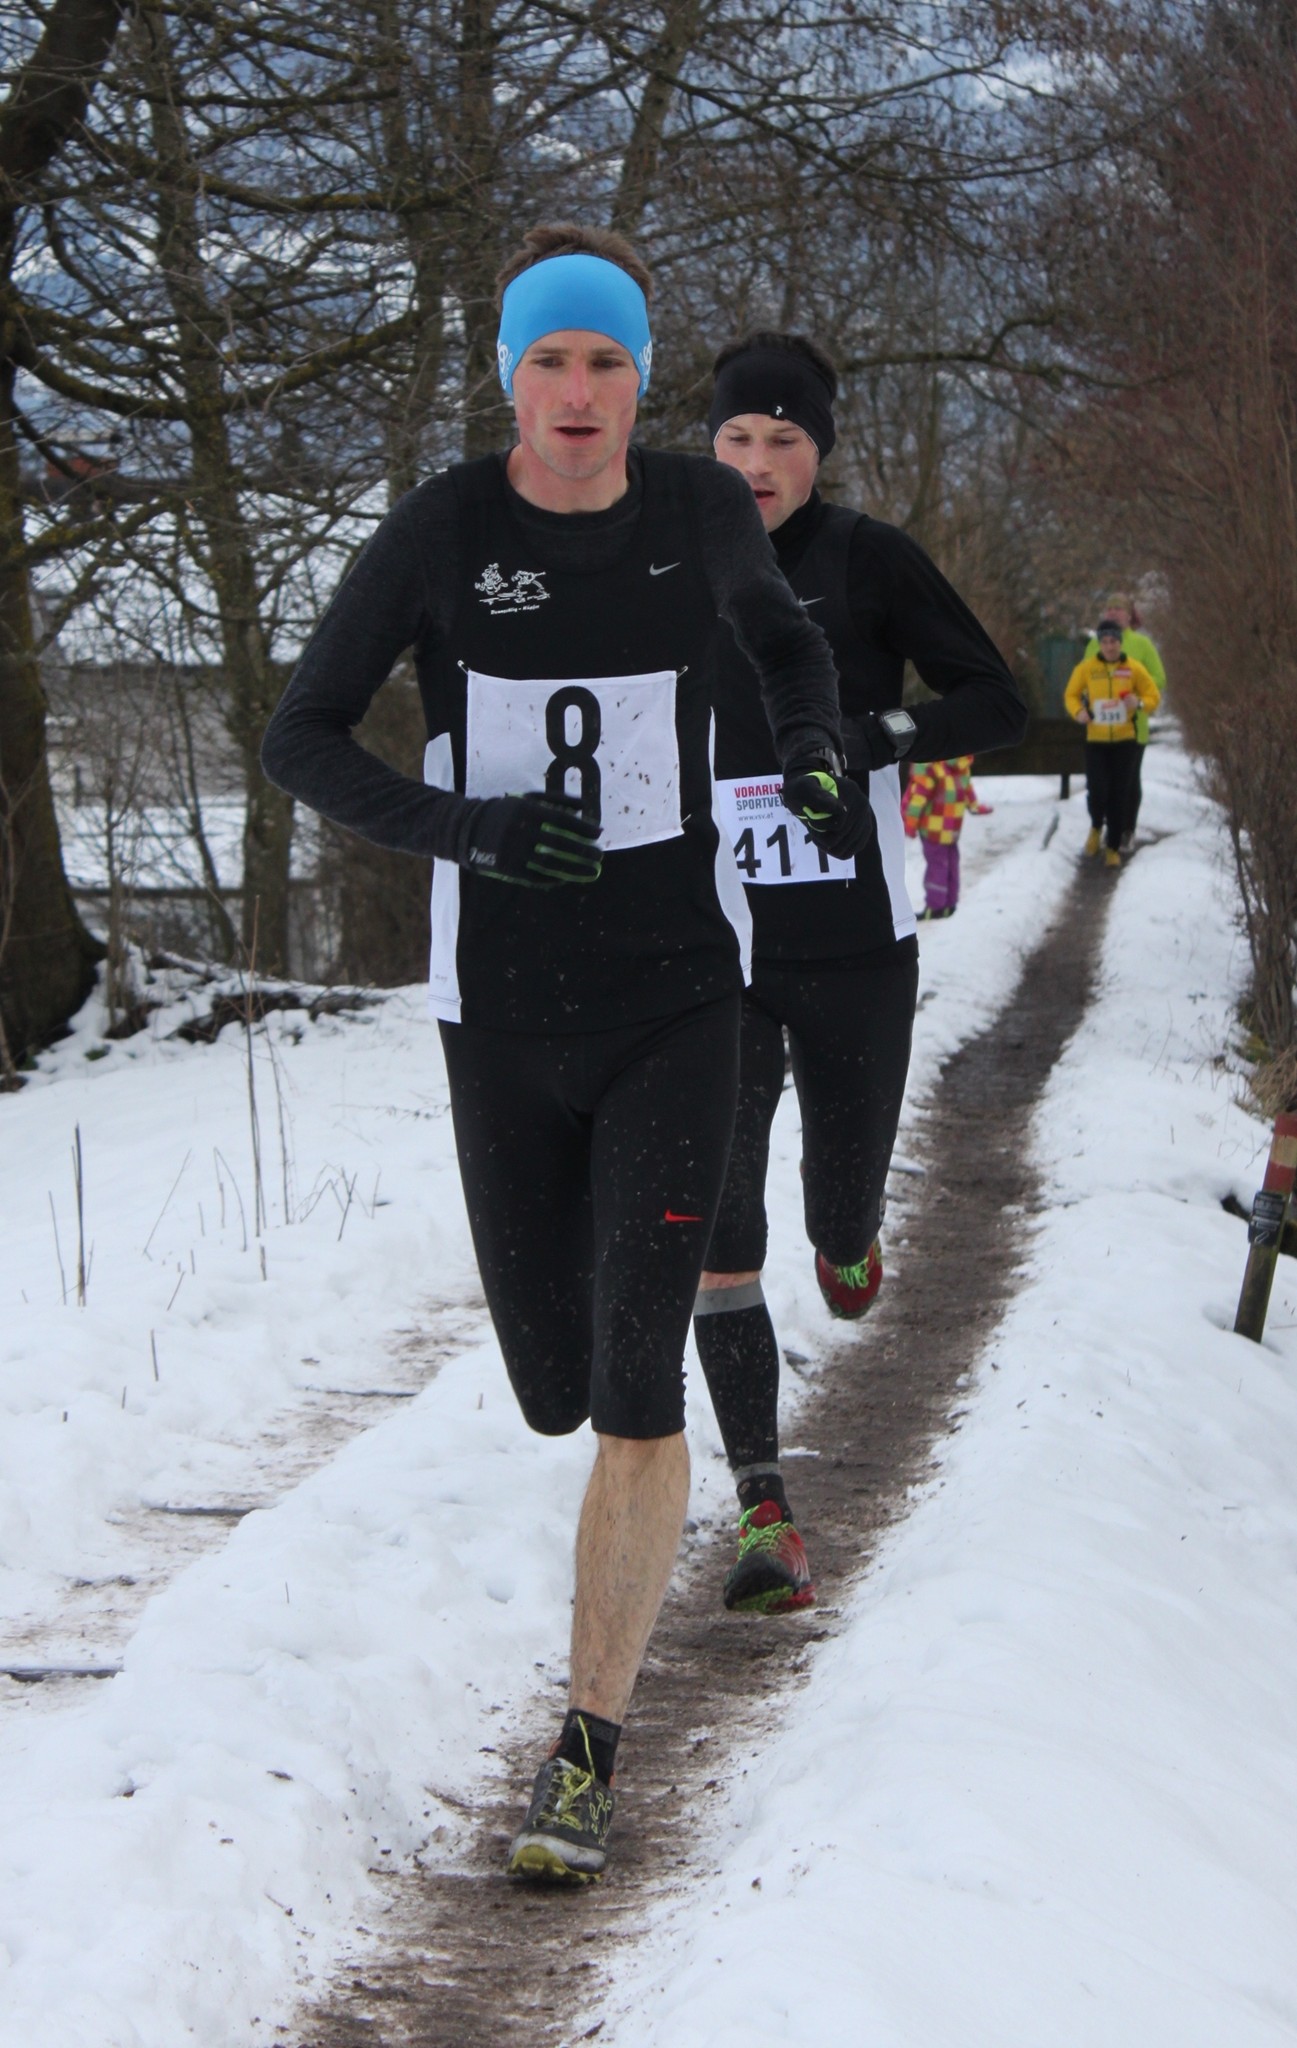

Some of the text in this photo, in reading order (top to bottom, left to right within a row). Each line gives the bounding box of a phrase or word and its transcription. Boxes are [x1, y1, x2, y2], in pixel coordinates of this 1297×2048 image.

[545, 685, 602, 829] 8
[734, 782, 784, 798] VORARLB
[736, 795, 784, 811] SPORTVE
[733, 824, 830, 878] 411
